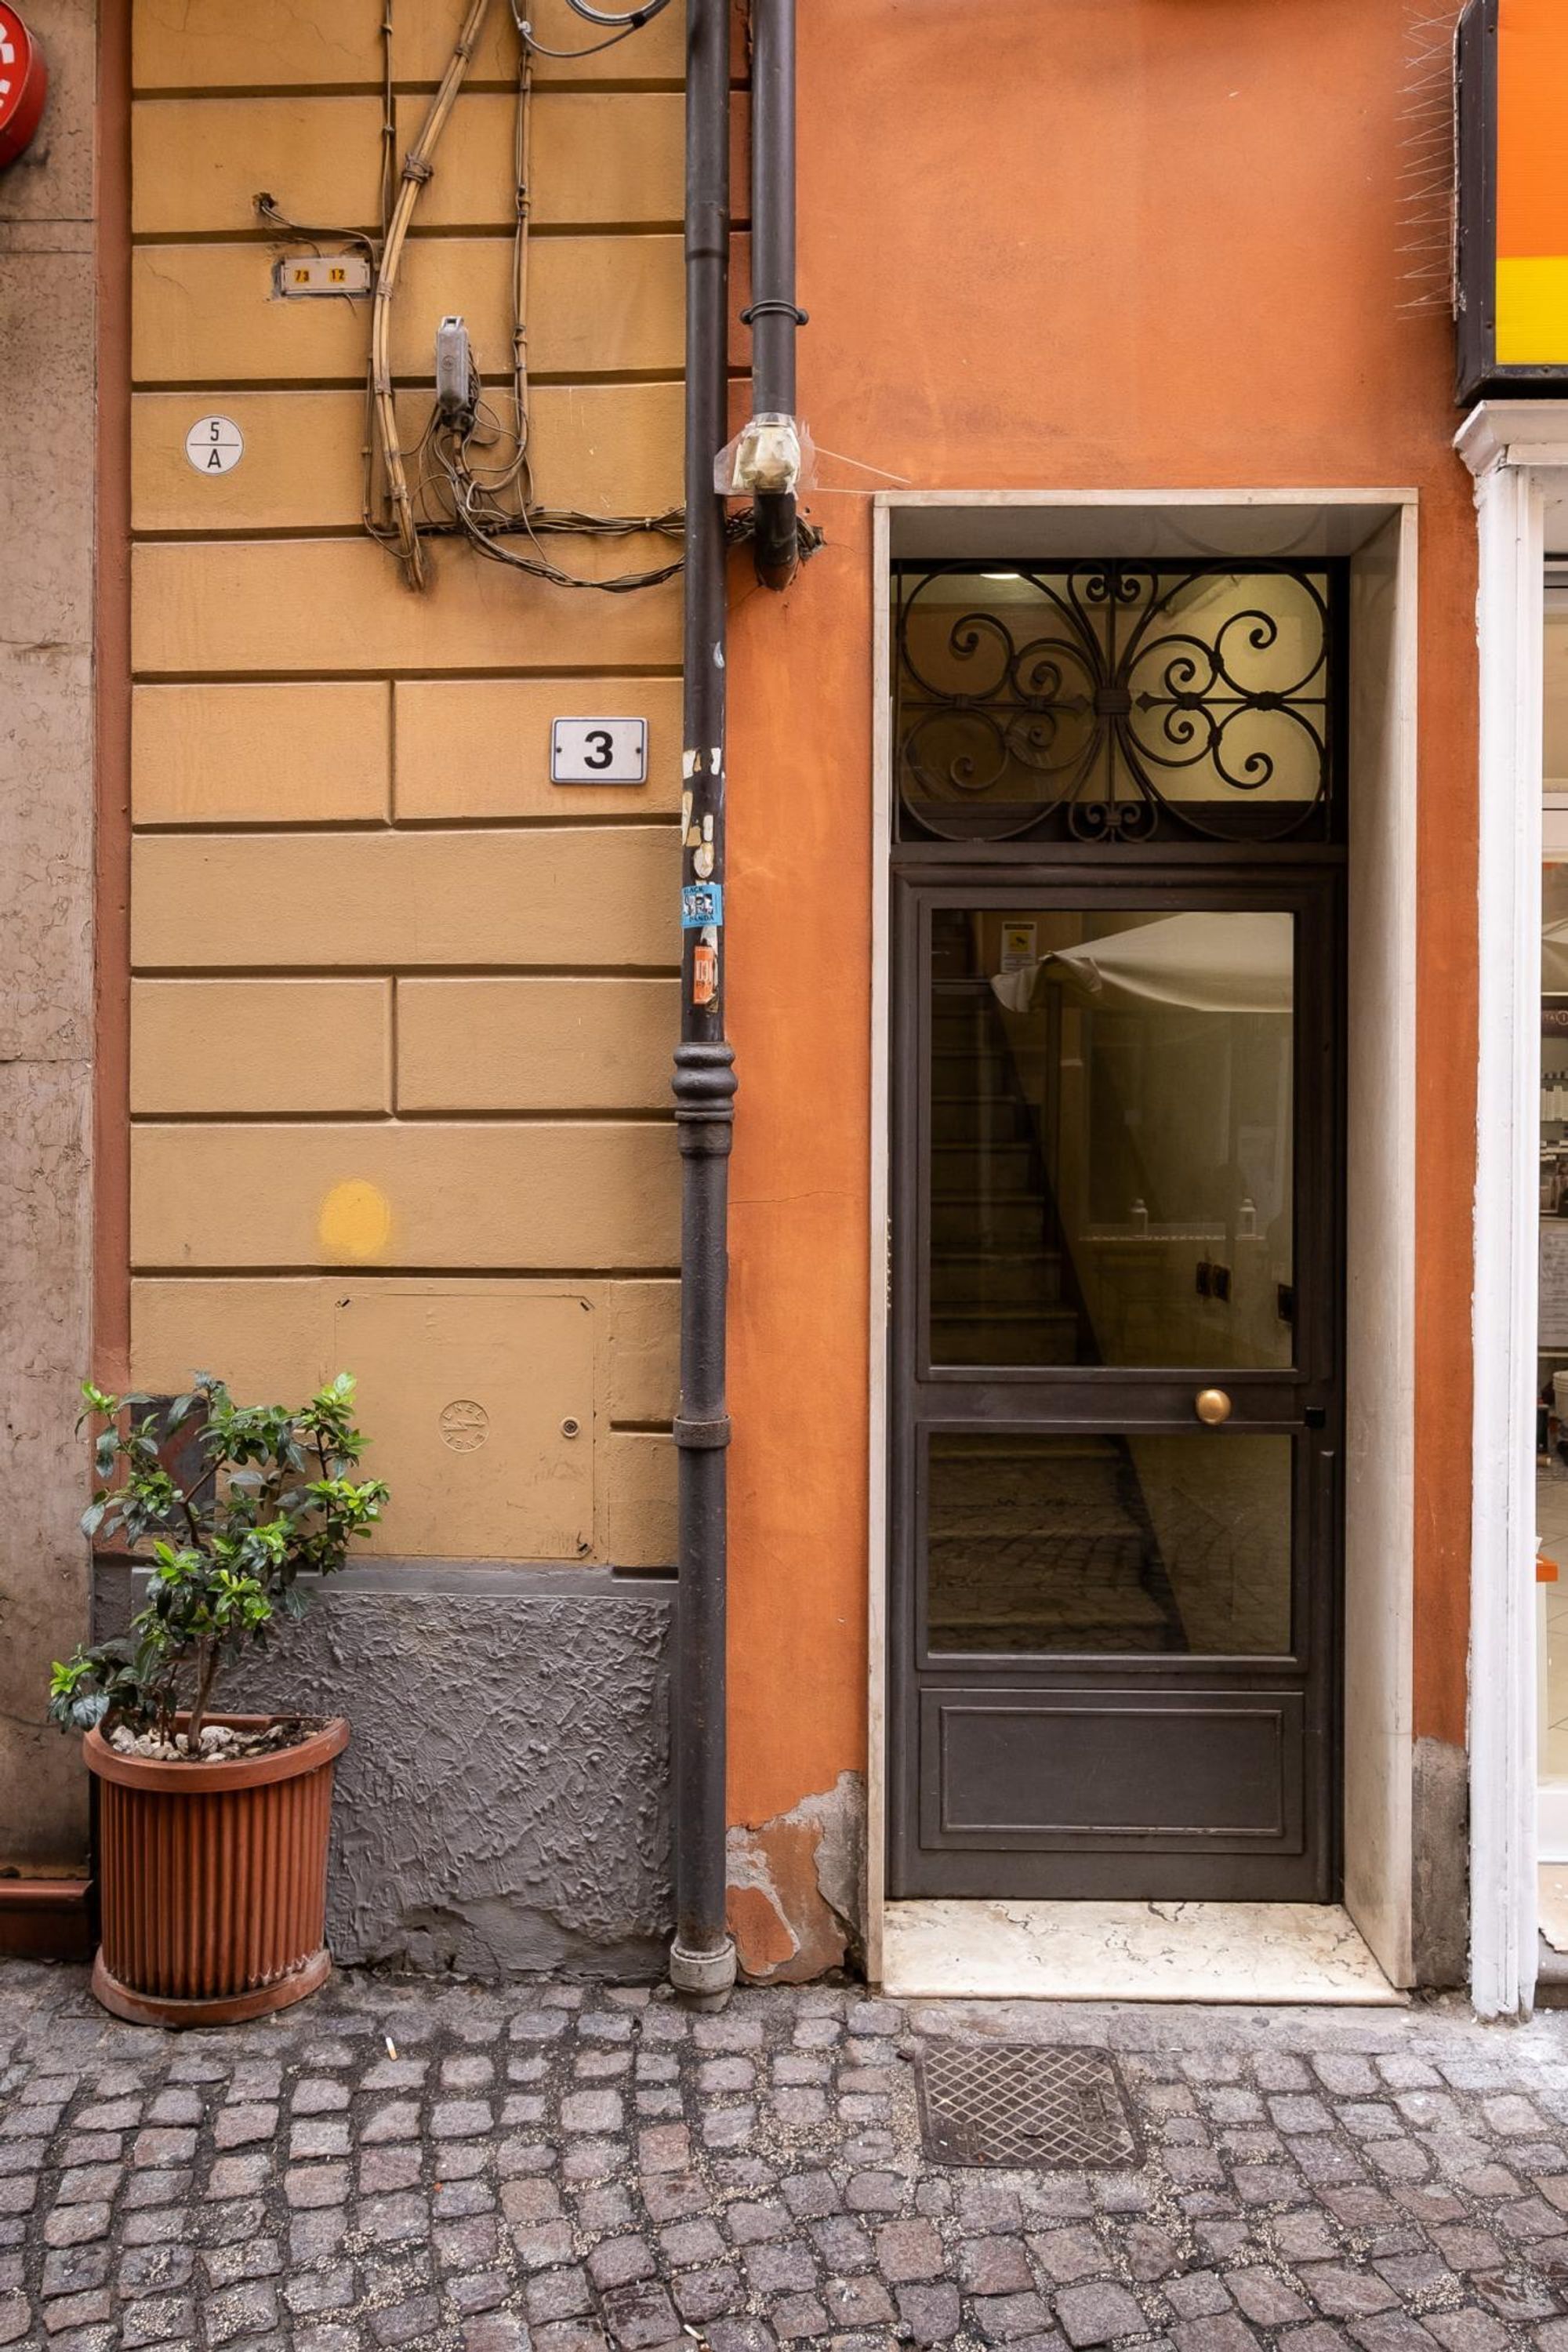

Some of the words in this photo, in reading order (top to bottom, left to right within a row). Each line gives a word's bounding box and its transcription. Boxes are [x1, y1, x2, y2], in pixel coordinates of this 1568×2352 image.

[295, 270, 310, 281] 73
[331, 269, 345, 280] 12
[210, 422, 220, 441] 5
[207, 448, 221, 468] A
[584, 730, 613, 770] 3
[442, 1403, 483, 1421] ENEL
